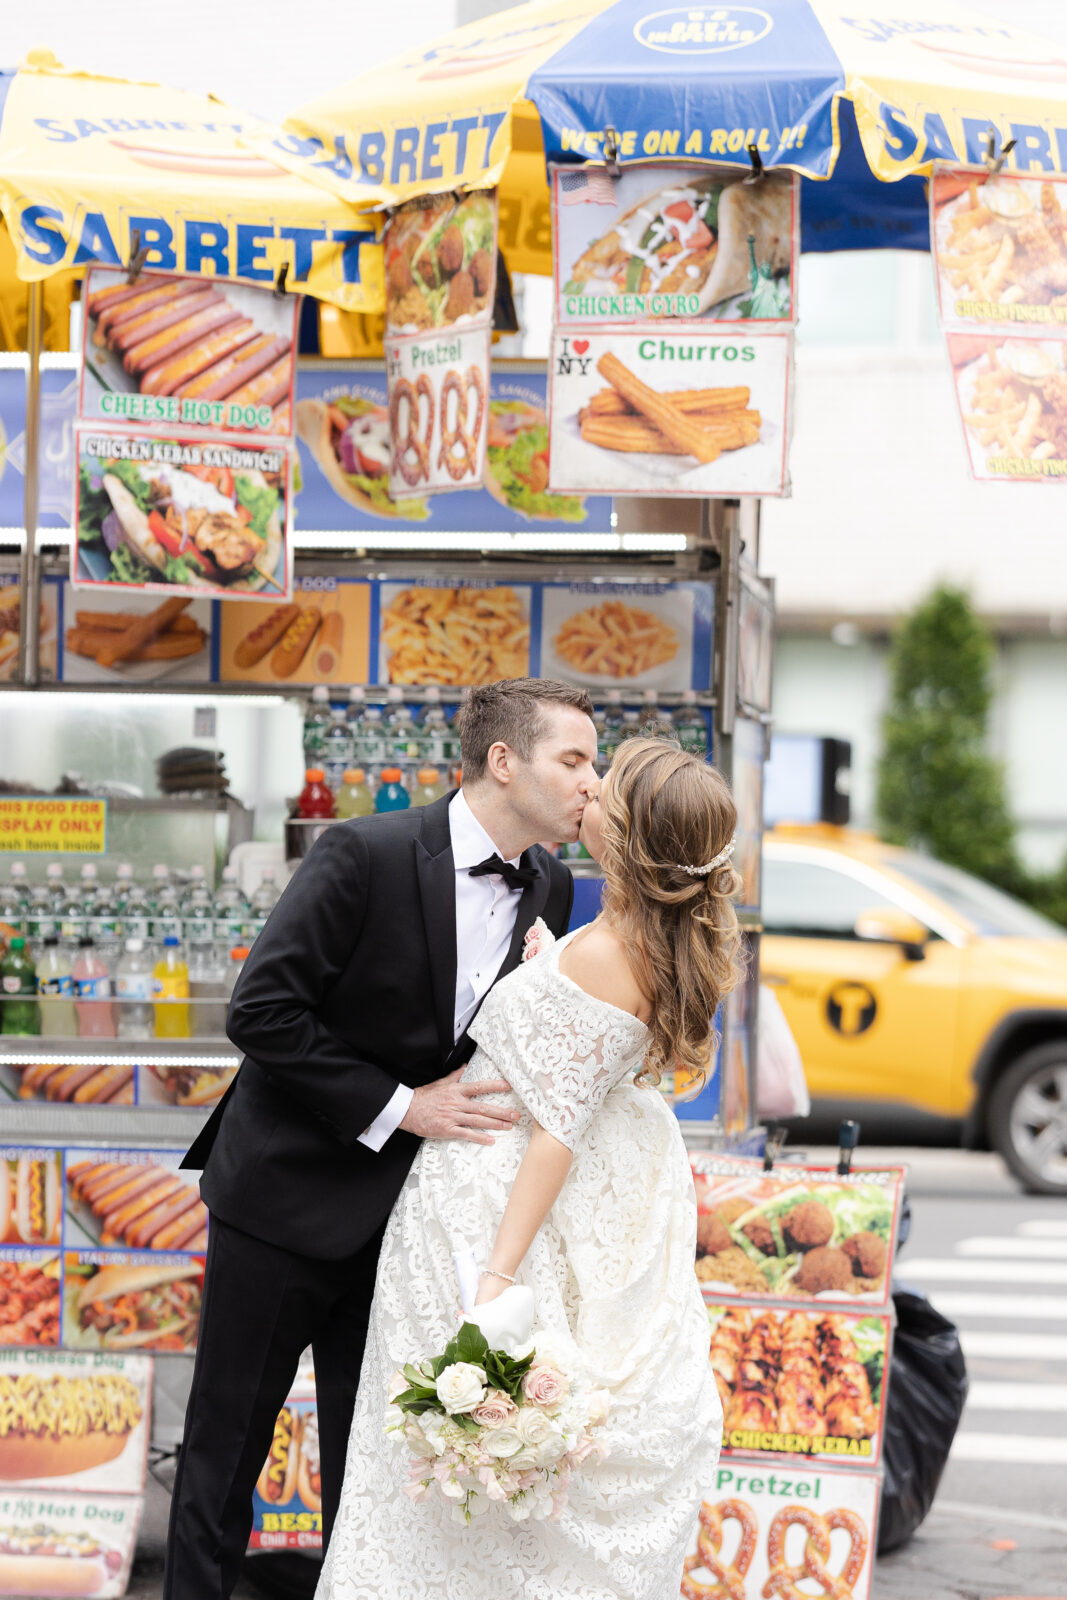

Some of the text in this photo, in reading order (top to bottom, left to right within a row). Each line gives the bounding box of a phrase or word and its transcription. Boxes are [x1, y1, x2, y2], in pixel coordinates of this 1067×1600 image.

[272, 111, 507, 186] SABRETT
[643, 129, 680, 154] ON
[685, 129, 702, 153] A
[710, 128, 770, 155] ROLL
[875, 101, 1067, 173] SABR
[20, 205, 376, 284] SABRETT
[566, 294, 700, 316] CHICKEN GYRO
[411, 338, 463, 368] Pretzel
[560, 338, 571, 357] I
[638, 339, 756, 362] Churros
[557, 357, 592, 376] NY
[101, 394, 178, 418] CHEESE
[183, 401, 224, 424] HOT
[229, 405, 272, 427] DOG
[86, 438, 282, 473] CHICKEN KEBAB SANDWICH
[27, 802, 66, 814] FOOD
[72, 802, 99, 814] FOR
[59, 819, 102, 834] ONLY
[94, 1352, 125, 1370] Dog
[730, 1430, 872, 1456] CHICKEN KEBAB
[716, 1469, 821, 1499] Pretzel
[39, 1502, 76, 1518] Hot
[85, 1505, 125, 1524] Dog
